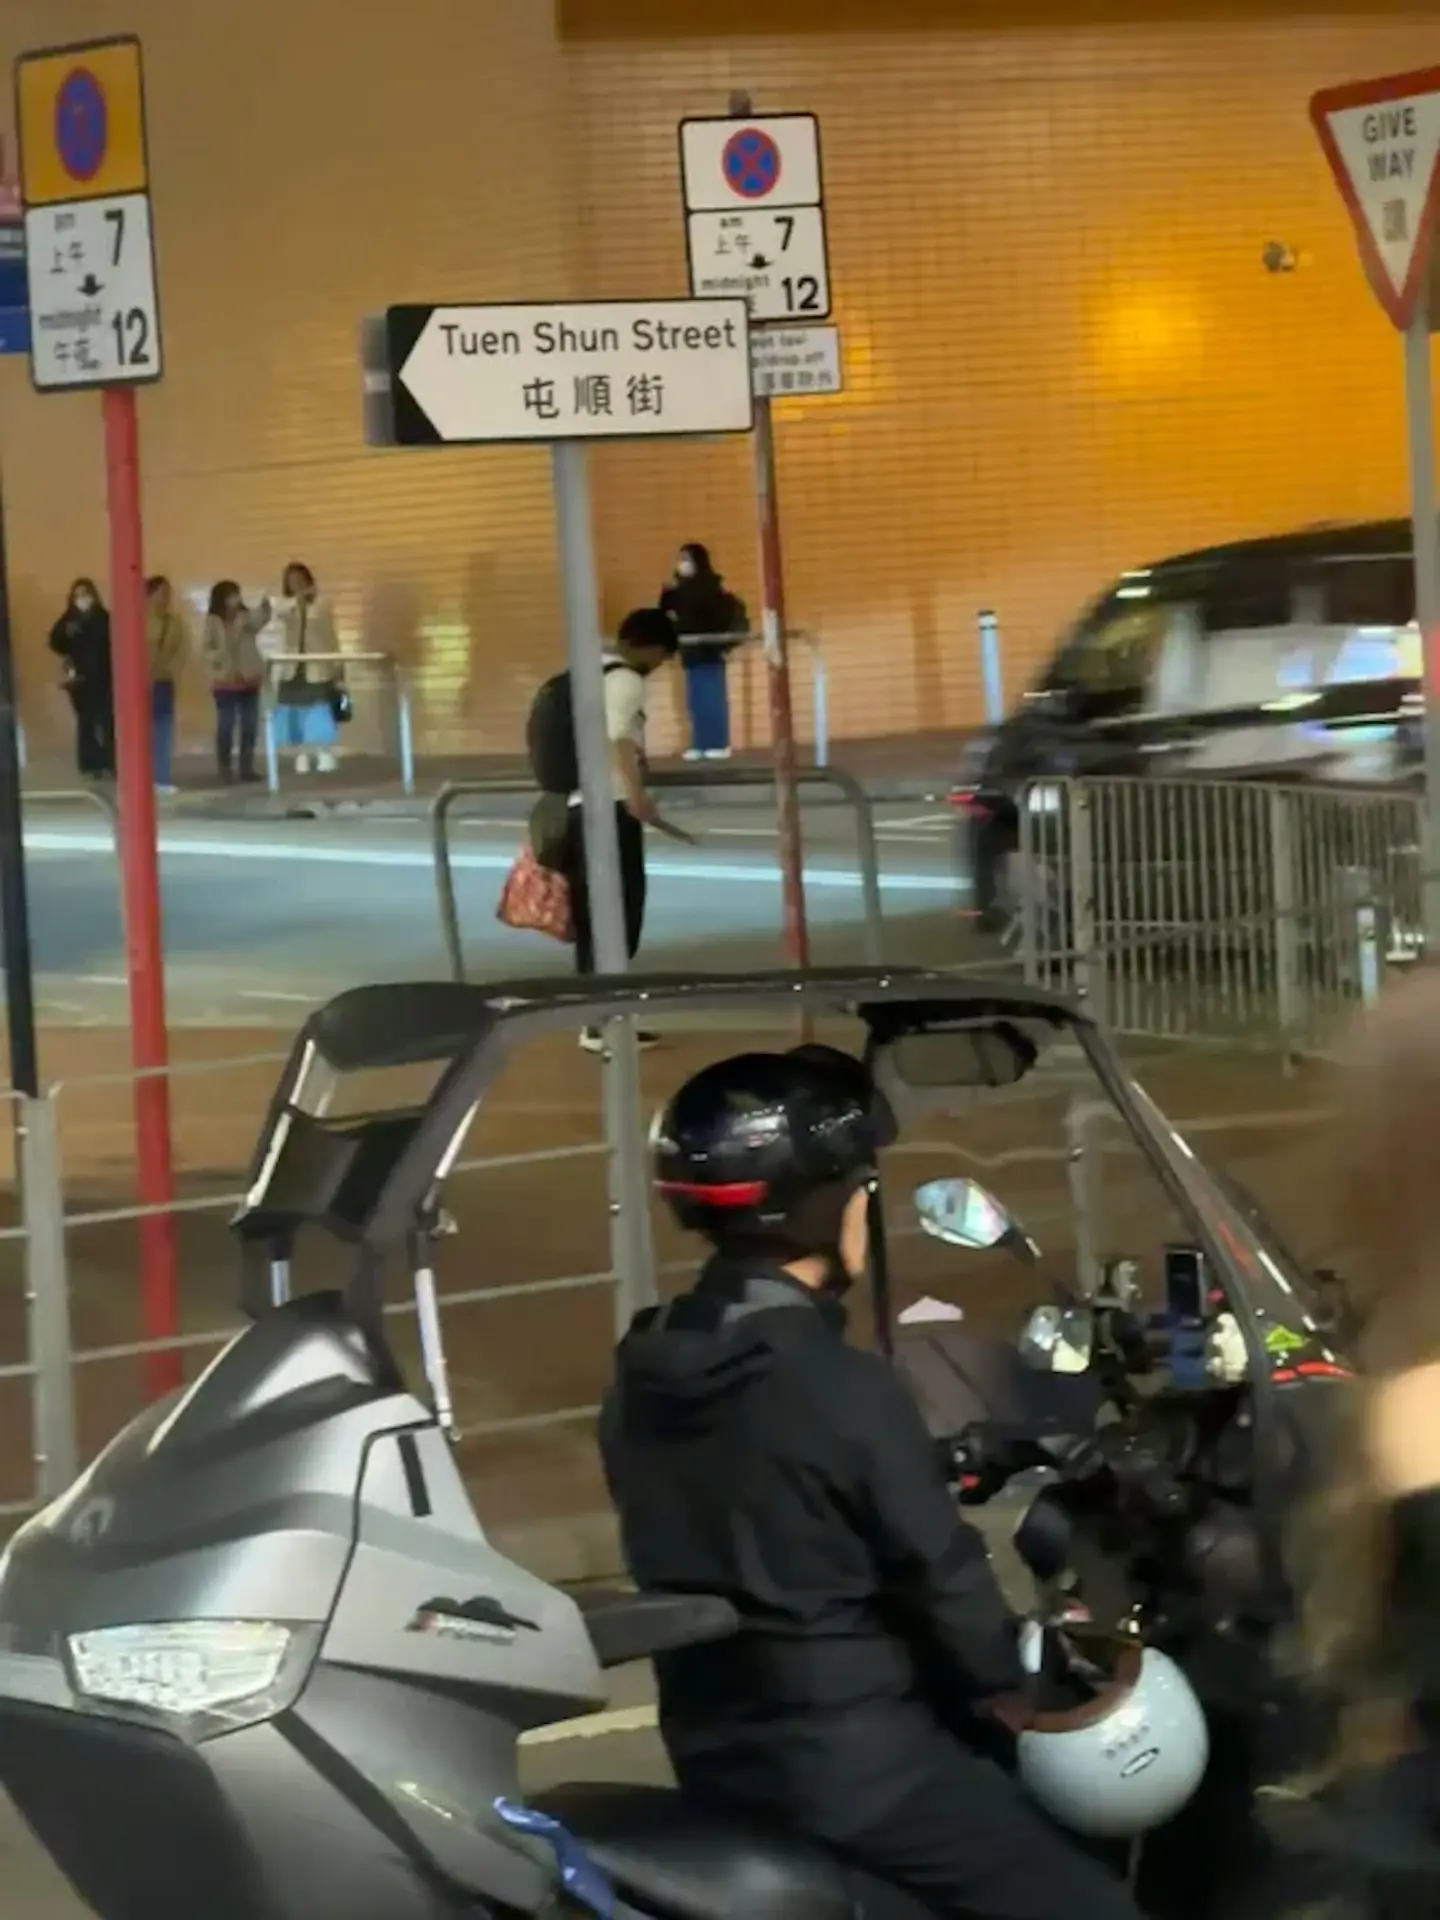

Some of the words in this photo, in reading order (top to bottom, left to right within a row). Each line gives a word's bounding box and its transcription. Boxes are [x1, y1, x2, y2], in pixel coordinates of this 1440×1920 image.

[1362, 107, 1416, 144] GIVE
[1367, 149, 1415, 182] WAY
[104, 208, 125, 266] 7
[714, 234, 752, 256] 上午
[773, 215, 795, 252] 7
[701, 274, 769, 291] midnight
[781, 275, 820, 312] 12
[111, 305, 150, 366] 12
[440, 324, 521, 356] Tuen
[533, 321, 619, 354] Shun
[632, 318, 737, 351] Street
[522, 373, 665, 420] 屯順街
